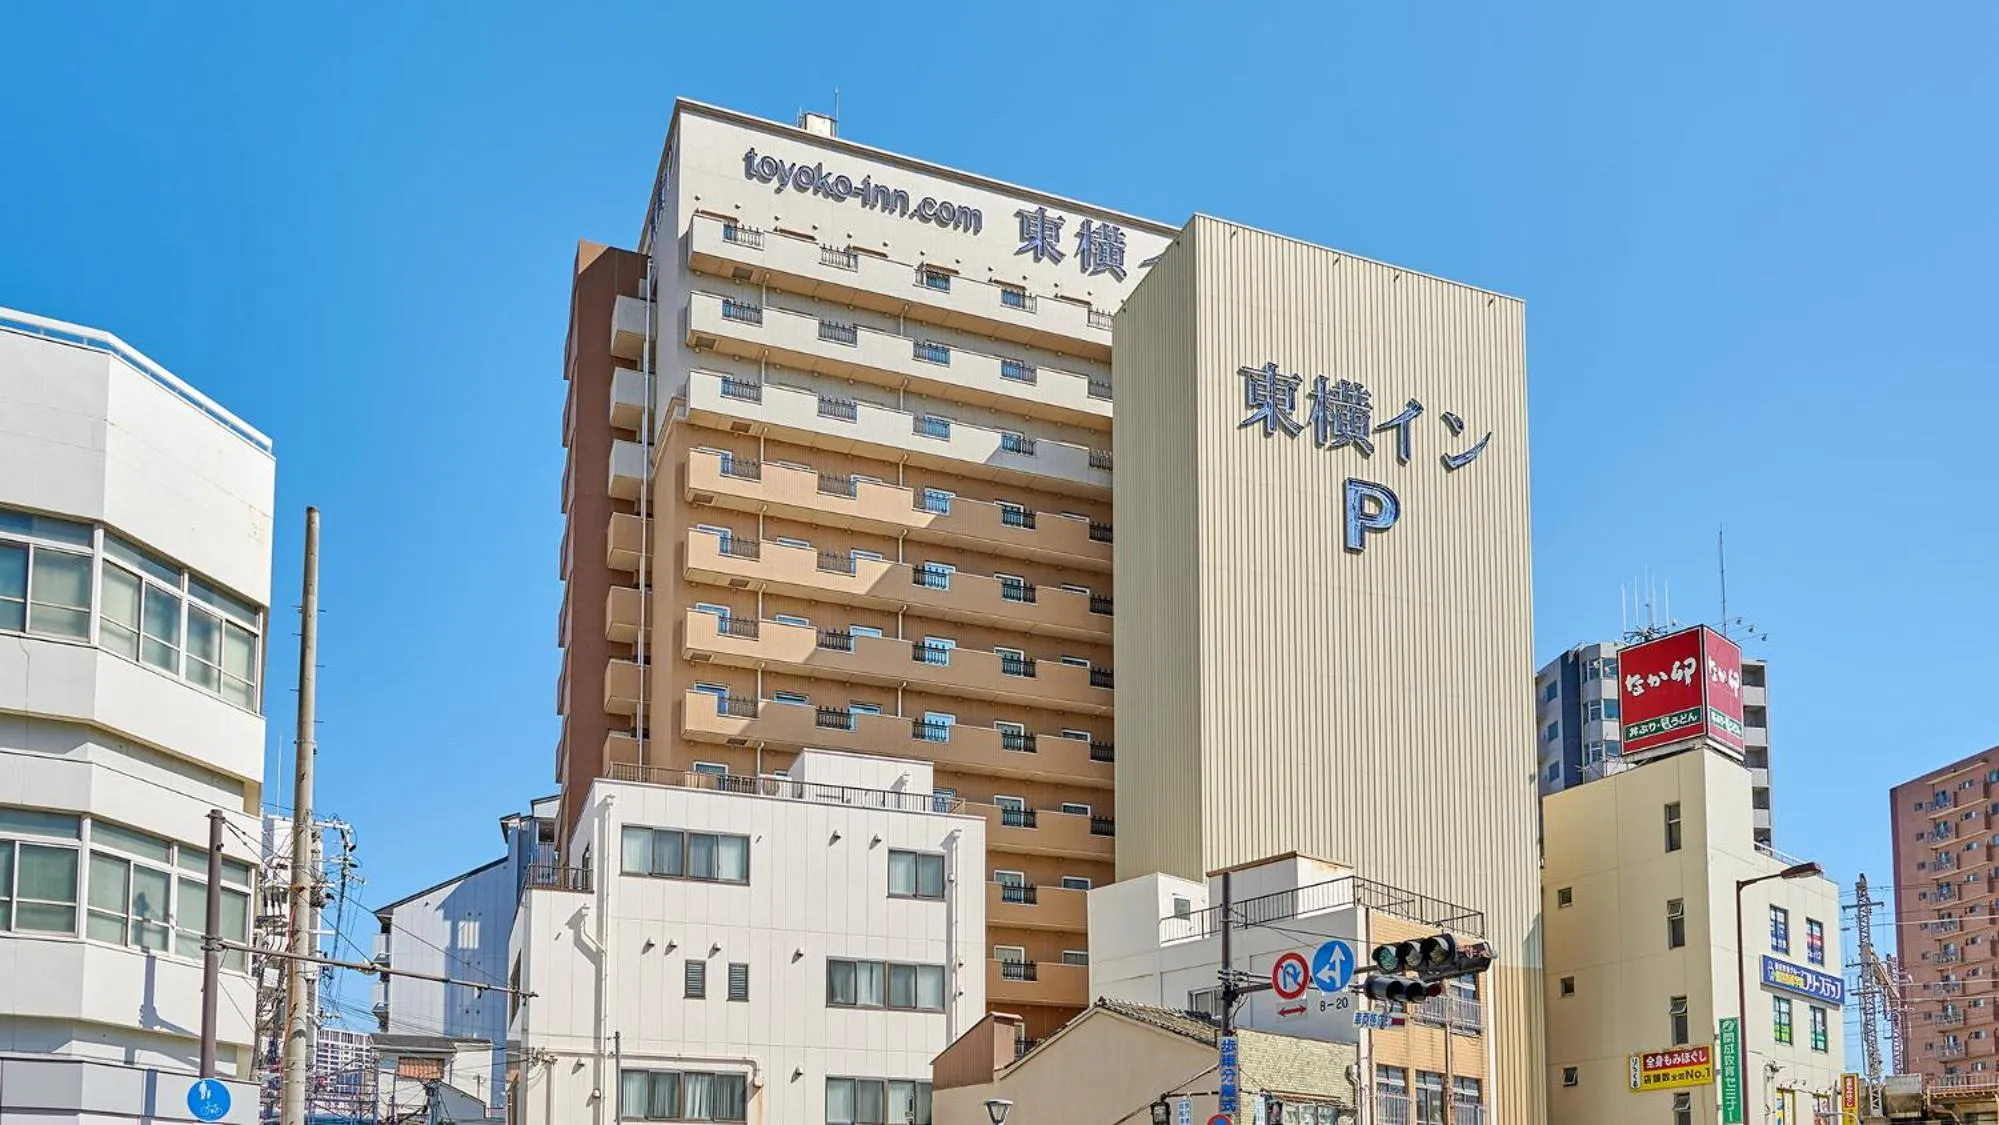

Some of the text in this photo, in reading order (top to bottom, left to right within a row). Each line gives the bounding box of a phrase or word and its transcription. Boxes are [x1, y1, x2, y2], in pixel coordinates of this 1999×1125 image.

[742, 146, 983, 234] toyoko-inn.com
[1237, 362, 1492, 473] 東横イン
[1342, 476, 1401, 554] P
[1625, 657, 1697, 697] なか卯
[1320, 996, 1348, 1012] 8-20
[1646, 1050, 1707, 1069] 全身もみほぐし
